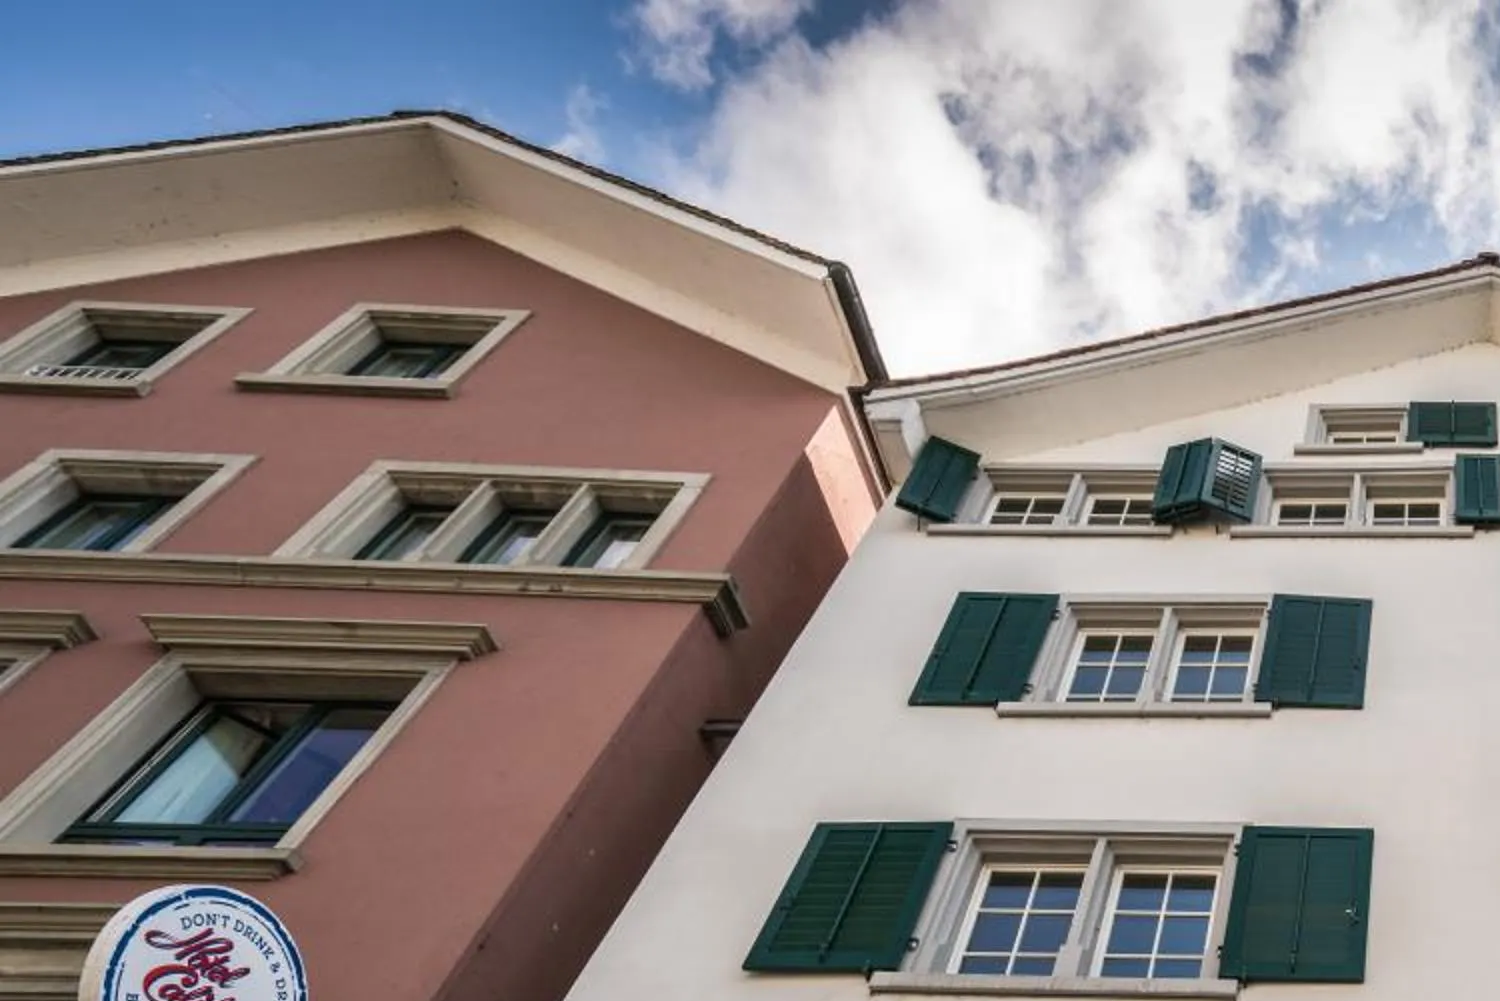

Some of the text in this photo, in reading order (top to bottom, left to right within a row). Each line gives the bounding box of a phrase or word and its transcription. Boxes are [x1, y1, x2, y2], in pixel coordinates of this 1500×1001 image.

[144, 928, 251, 987] Hotel
[180, 914, 231, 930] DON'T
[233, 919, 276, 961] DRINK
[271, 962, 281, 974] &
